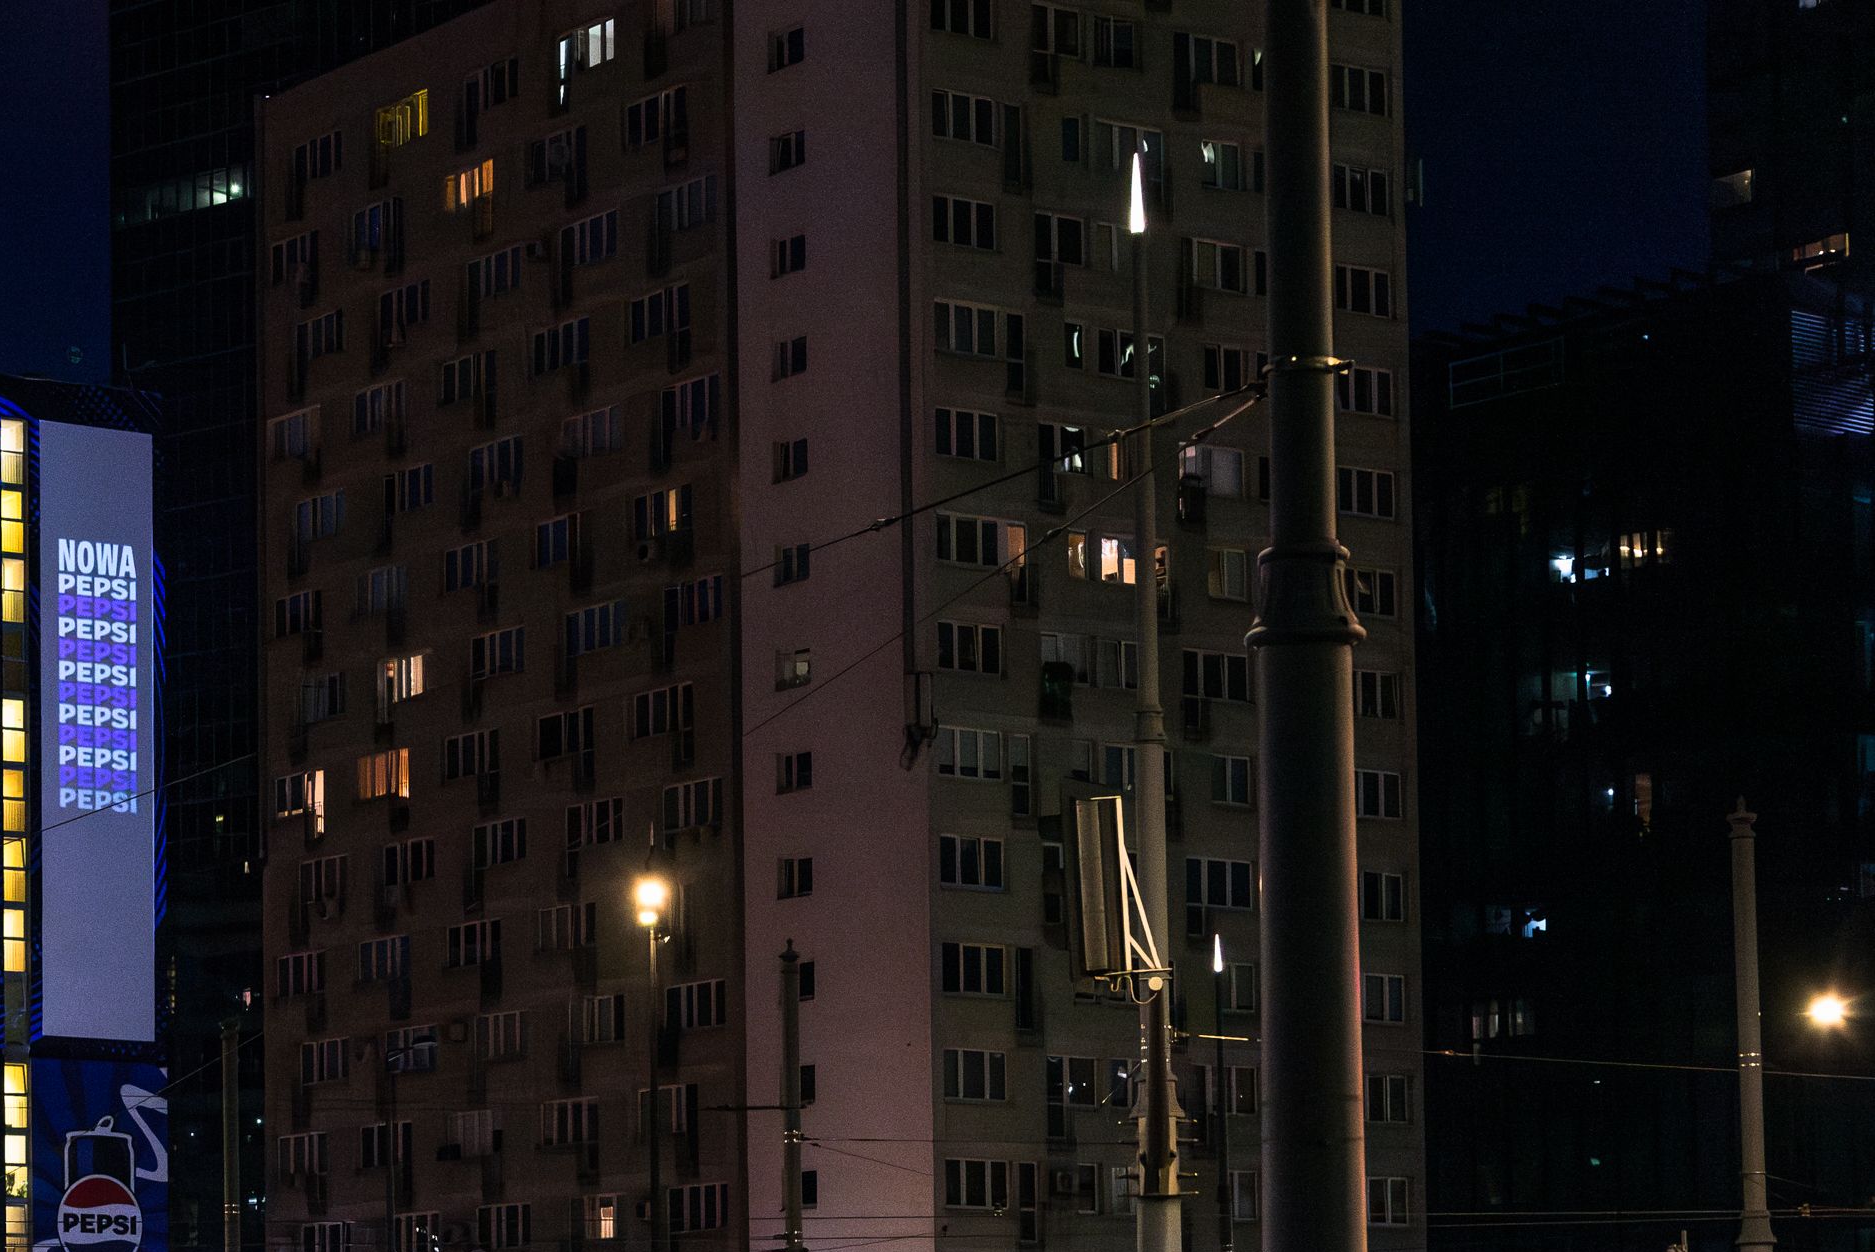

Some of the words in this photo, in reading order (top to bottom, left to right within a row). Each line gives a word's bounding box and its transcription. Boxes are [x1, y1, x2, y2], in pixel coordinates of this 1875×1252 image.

[58, 538, 137, 579] NOWA
[58, 573, 137, 601] PEPSI
[58, 595, 137, 622] PEPSI
[58, 617, 137, 644] PEPSI
[58, 638, 137, 667] PEPSI
[58, 660, 137, 687] PEPSI
[58, 682, 137, 710] PEPSI
[58, 703, 137, 730] PEPSI
[58, 724, 137, 752] PEPSI
[58, 745, 137, 772] PEPSI
[58, 766, 137, 793] PEPSI
[58, 787, 137, 815] PEPSI
[62, 1212, 137, 1236] PEPSI
